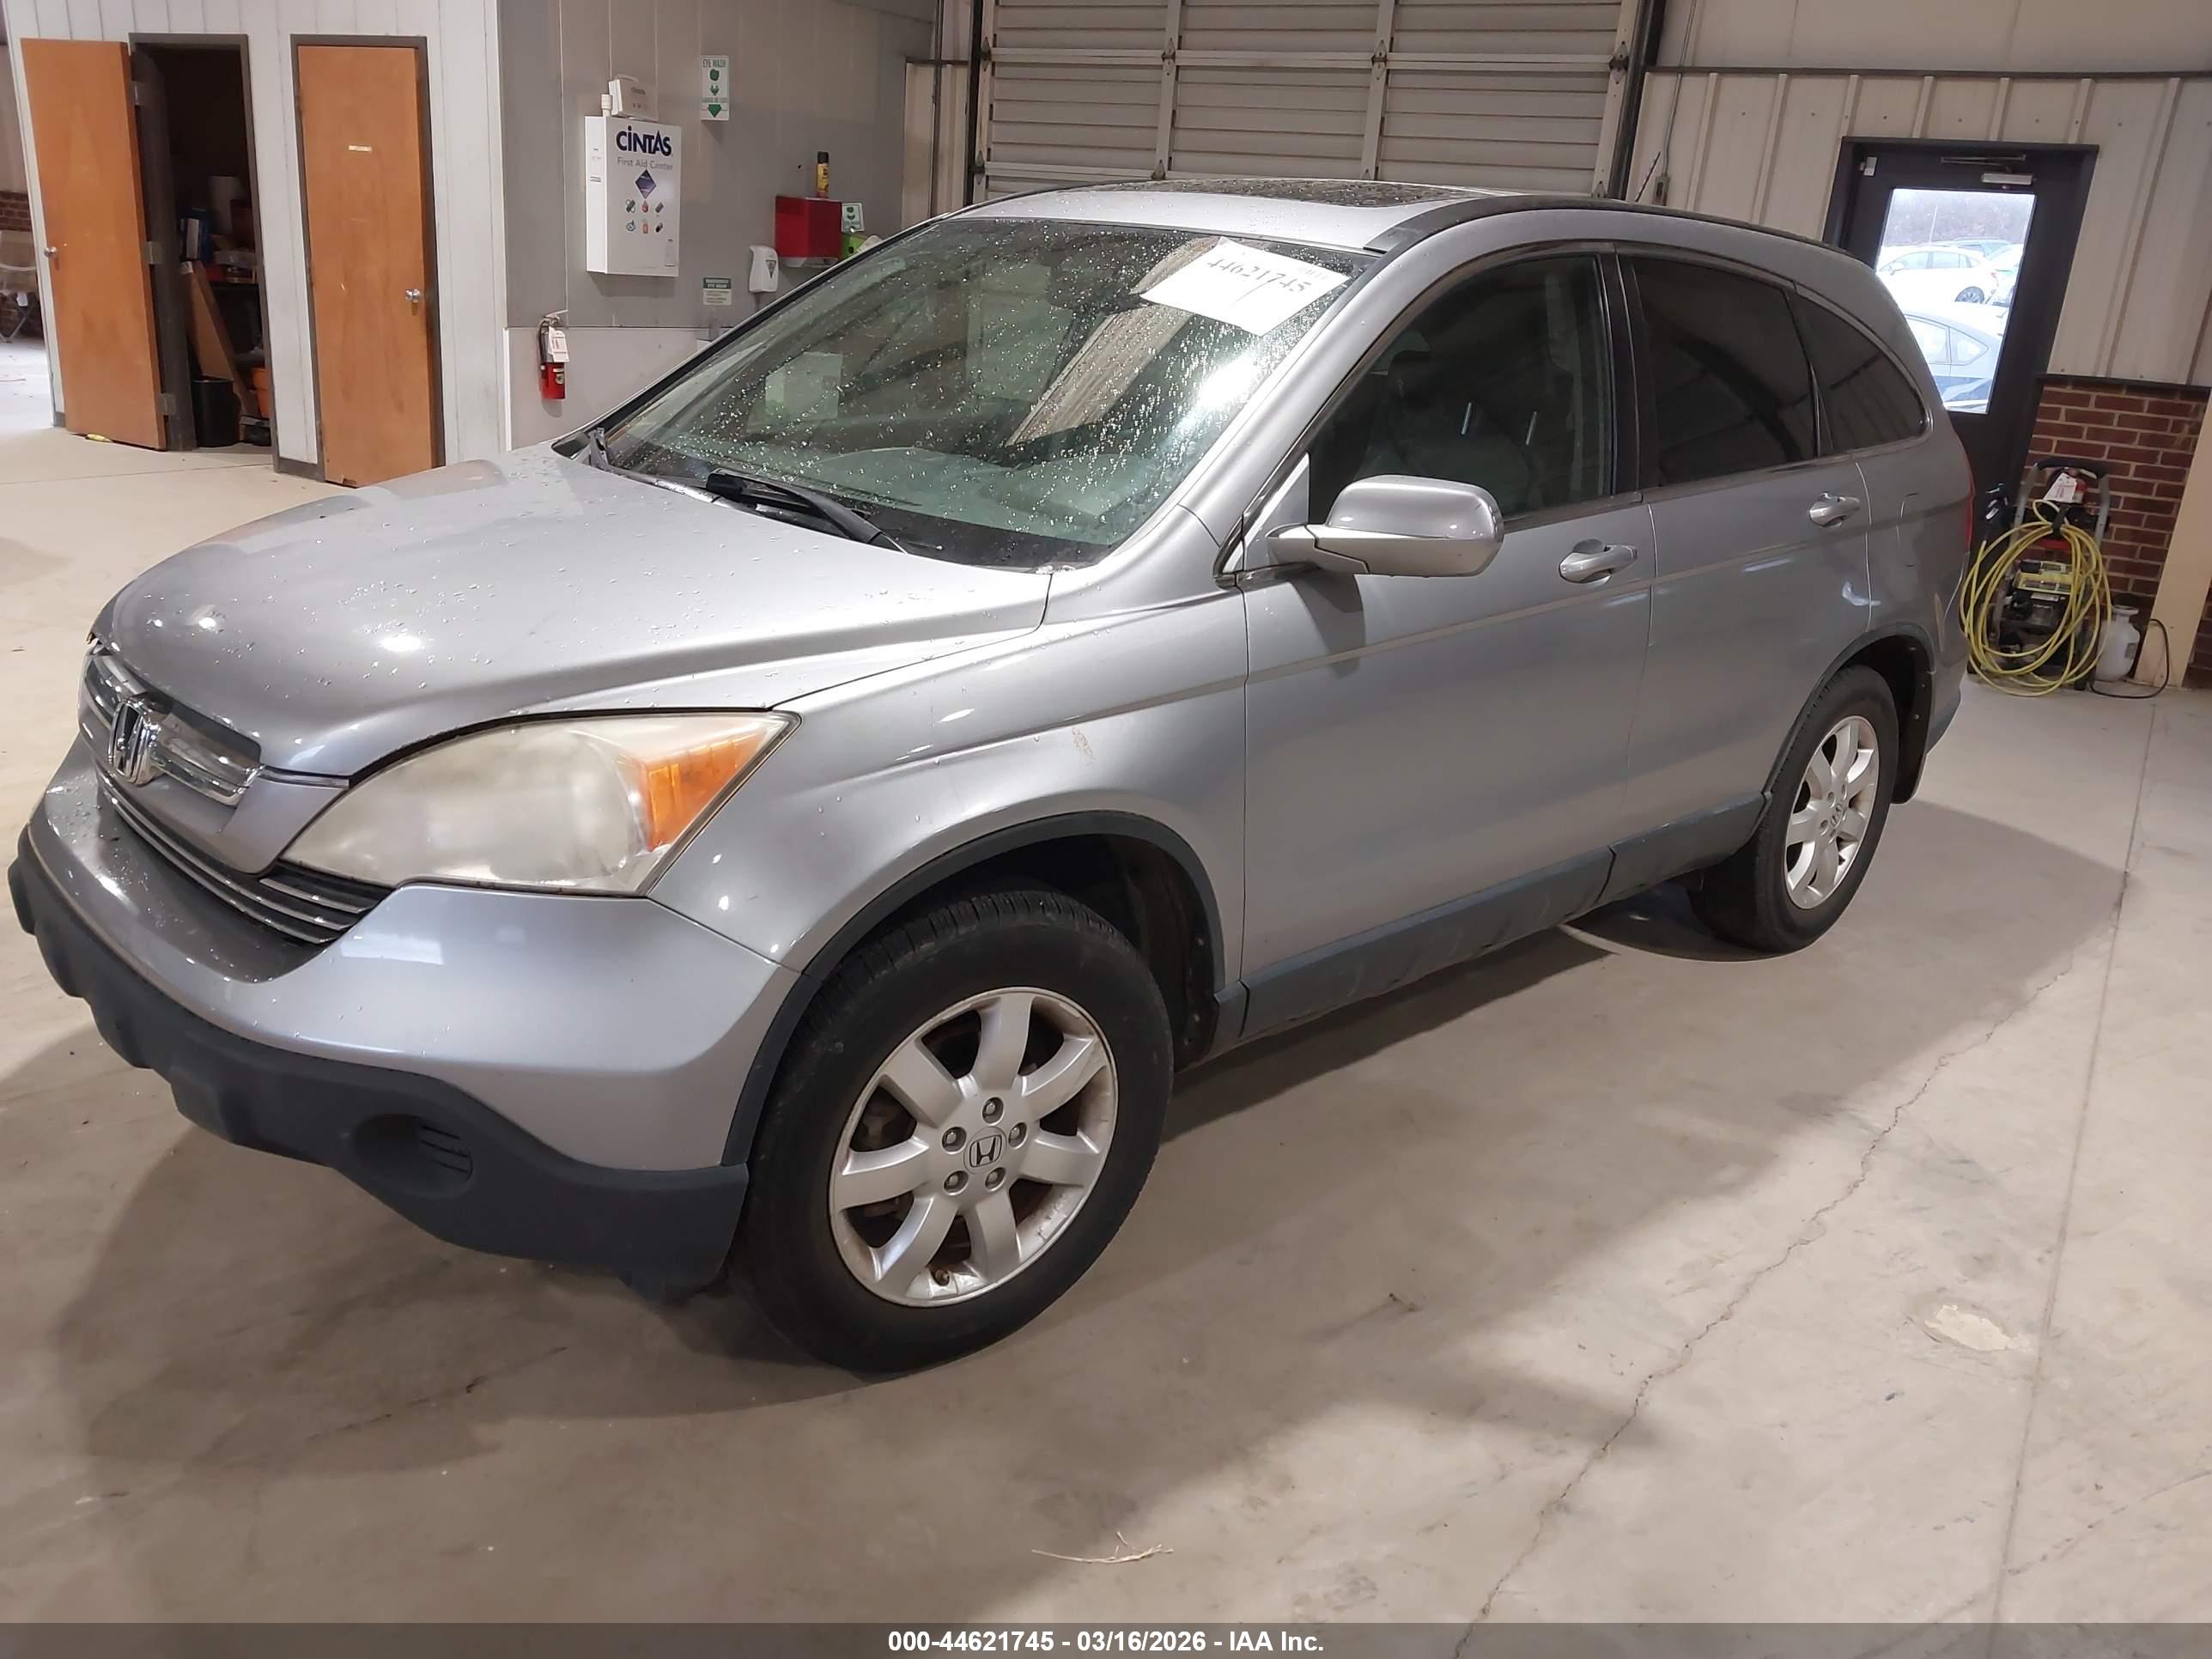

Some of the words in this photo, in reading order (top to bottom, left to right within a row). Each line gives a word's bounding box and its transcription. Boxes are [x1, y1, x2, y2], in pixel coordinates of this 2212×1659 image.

[617, 156, 633, 167] First
[635, 158, 647, 168] Aid
[650, 160, 673, 171] Center
